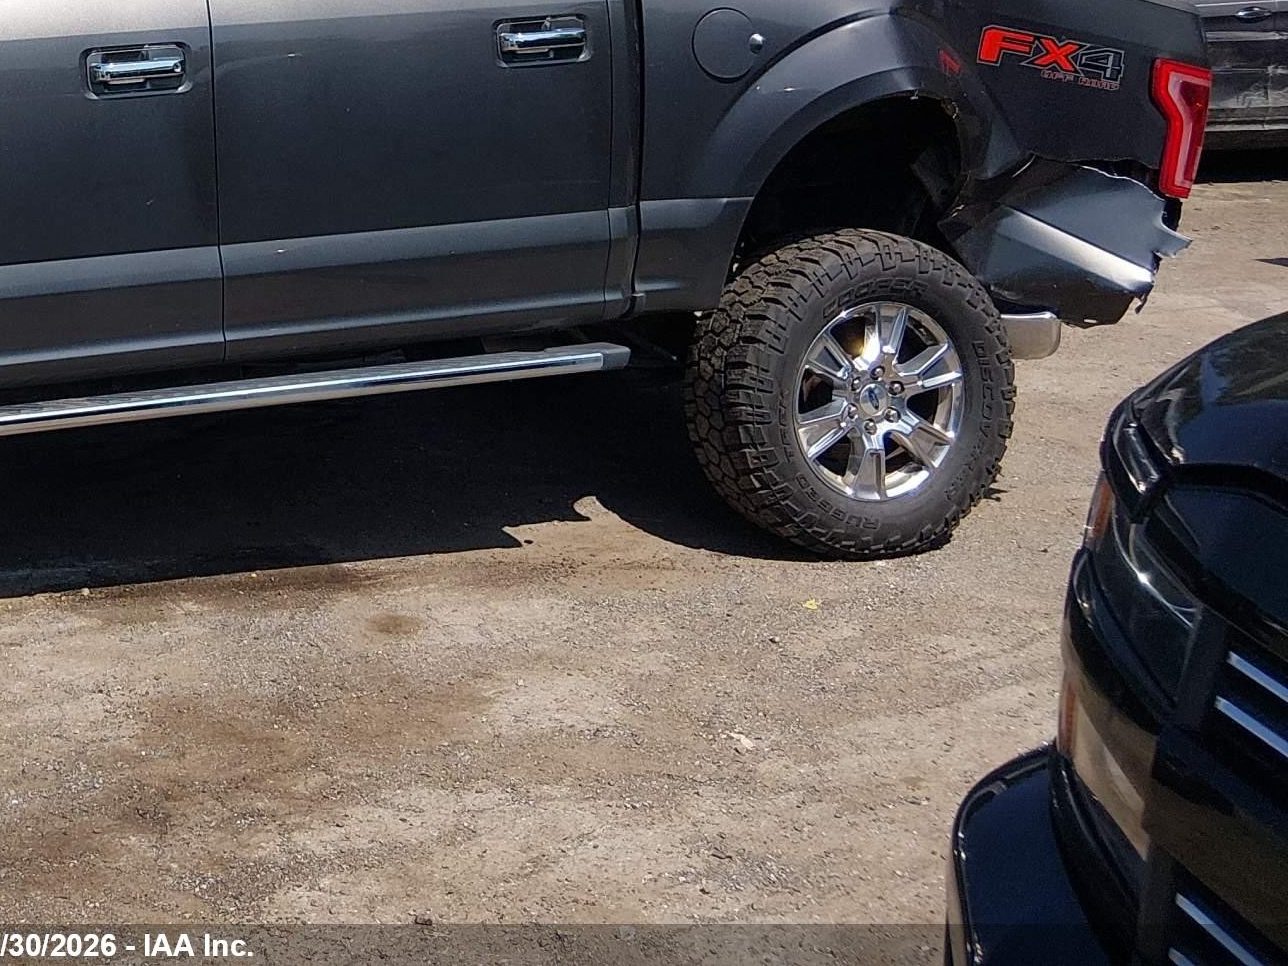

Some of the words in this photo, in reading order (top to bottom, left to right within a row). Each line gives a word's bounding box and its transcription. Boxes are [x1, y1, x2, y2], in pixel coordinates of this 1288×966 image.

[977, 25, 1125, 83] FX4
[1041, 69, 1074, 82] OFF
[1079, 77, 1120, 91] ROAD
[822, 277, 930, 320] COOPER
[795, 472, 882, 531] RUGGED
